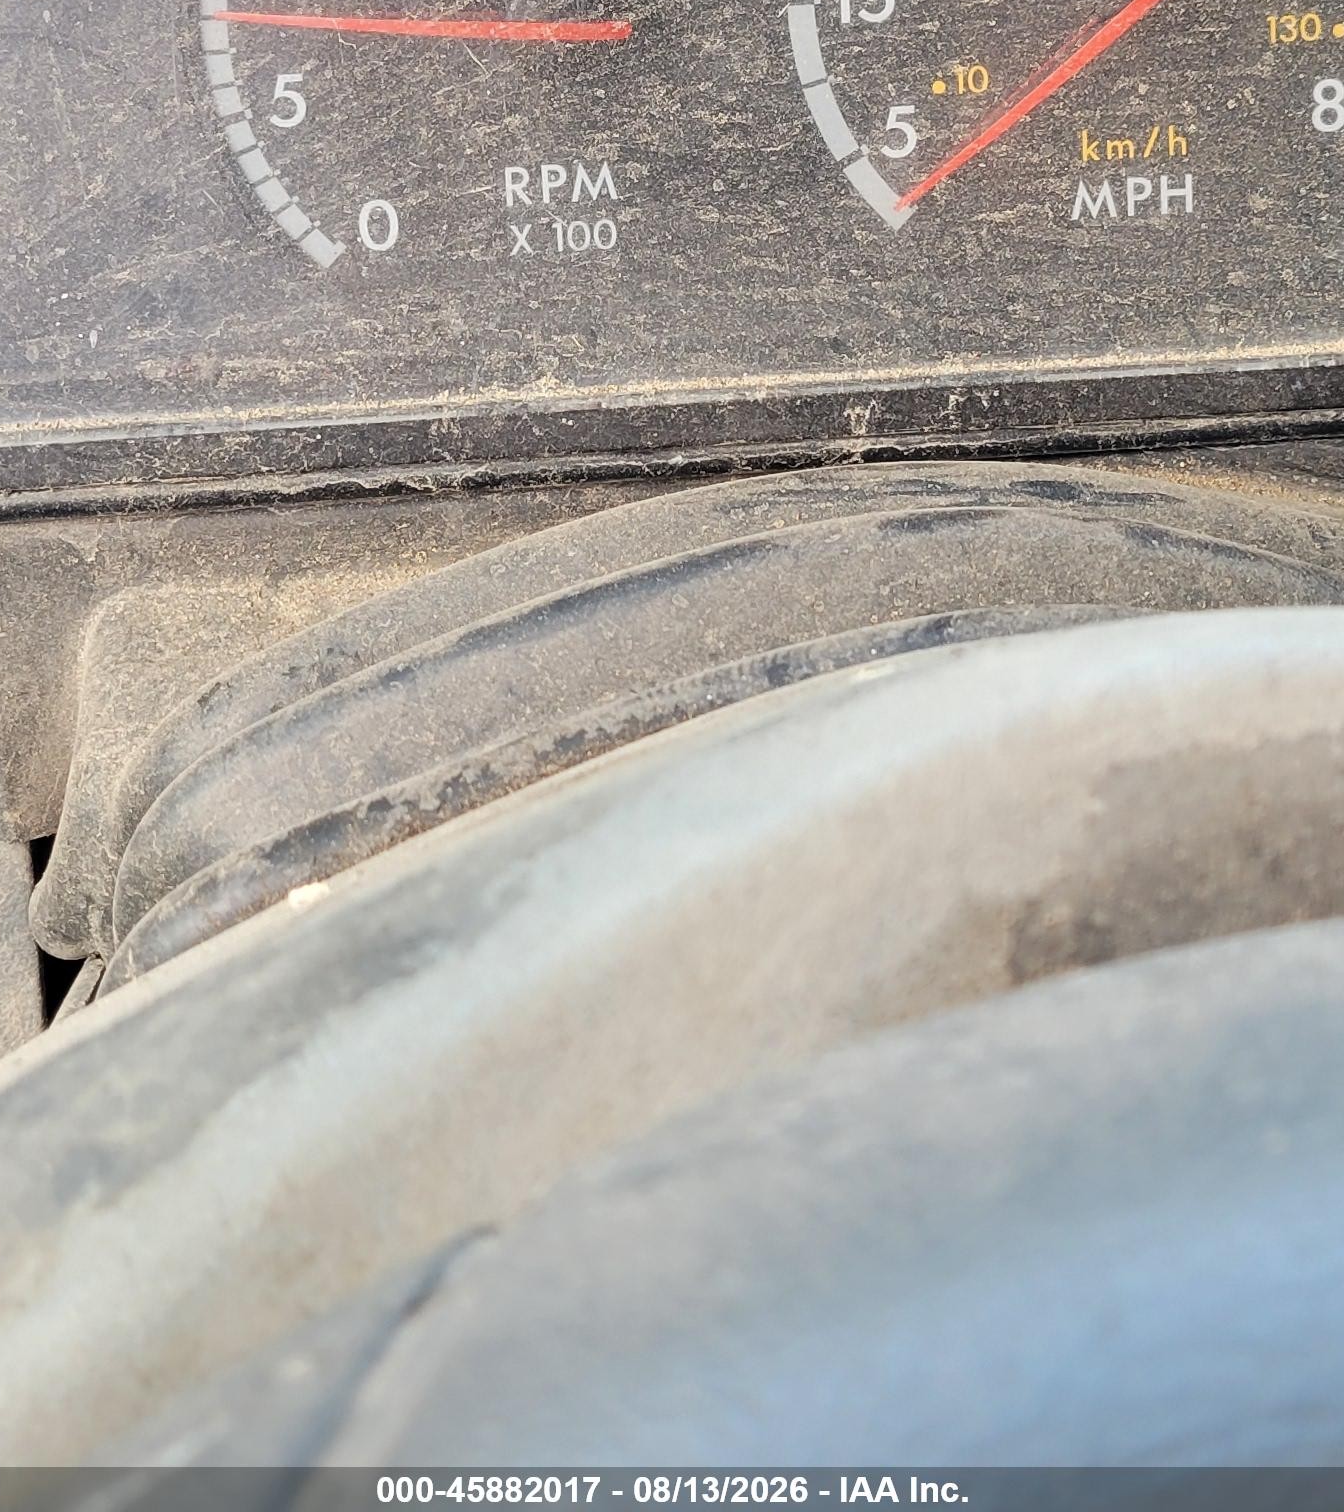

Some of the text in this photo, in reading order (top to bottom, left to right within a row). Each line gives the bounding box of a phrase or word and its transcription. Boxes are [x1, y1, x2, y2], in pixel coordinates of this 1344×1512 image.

[1266, 13, 1323, 45] 130
[269, 73, 308, 129] 5
[953, 64, 990, 95] 10
[880, 104, 918, 159] 5
[1080, 123, 1190, 164] km/h
[503, 161, 619, 208] RPM
[1069, 172, 1195, 222] MPH
[357, 198, 400, 252] 0
[554, 218, 618, 253] 100
